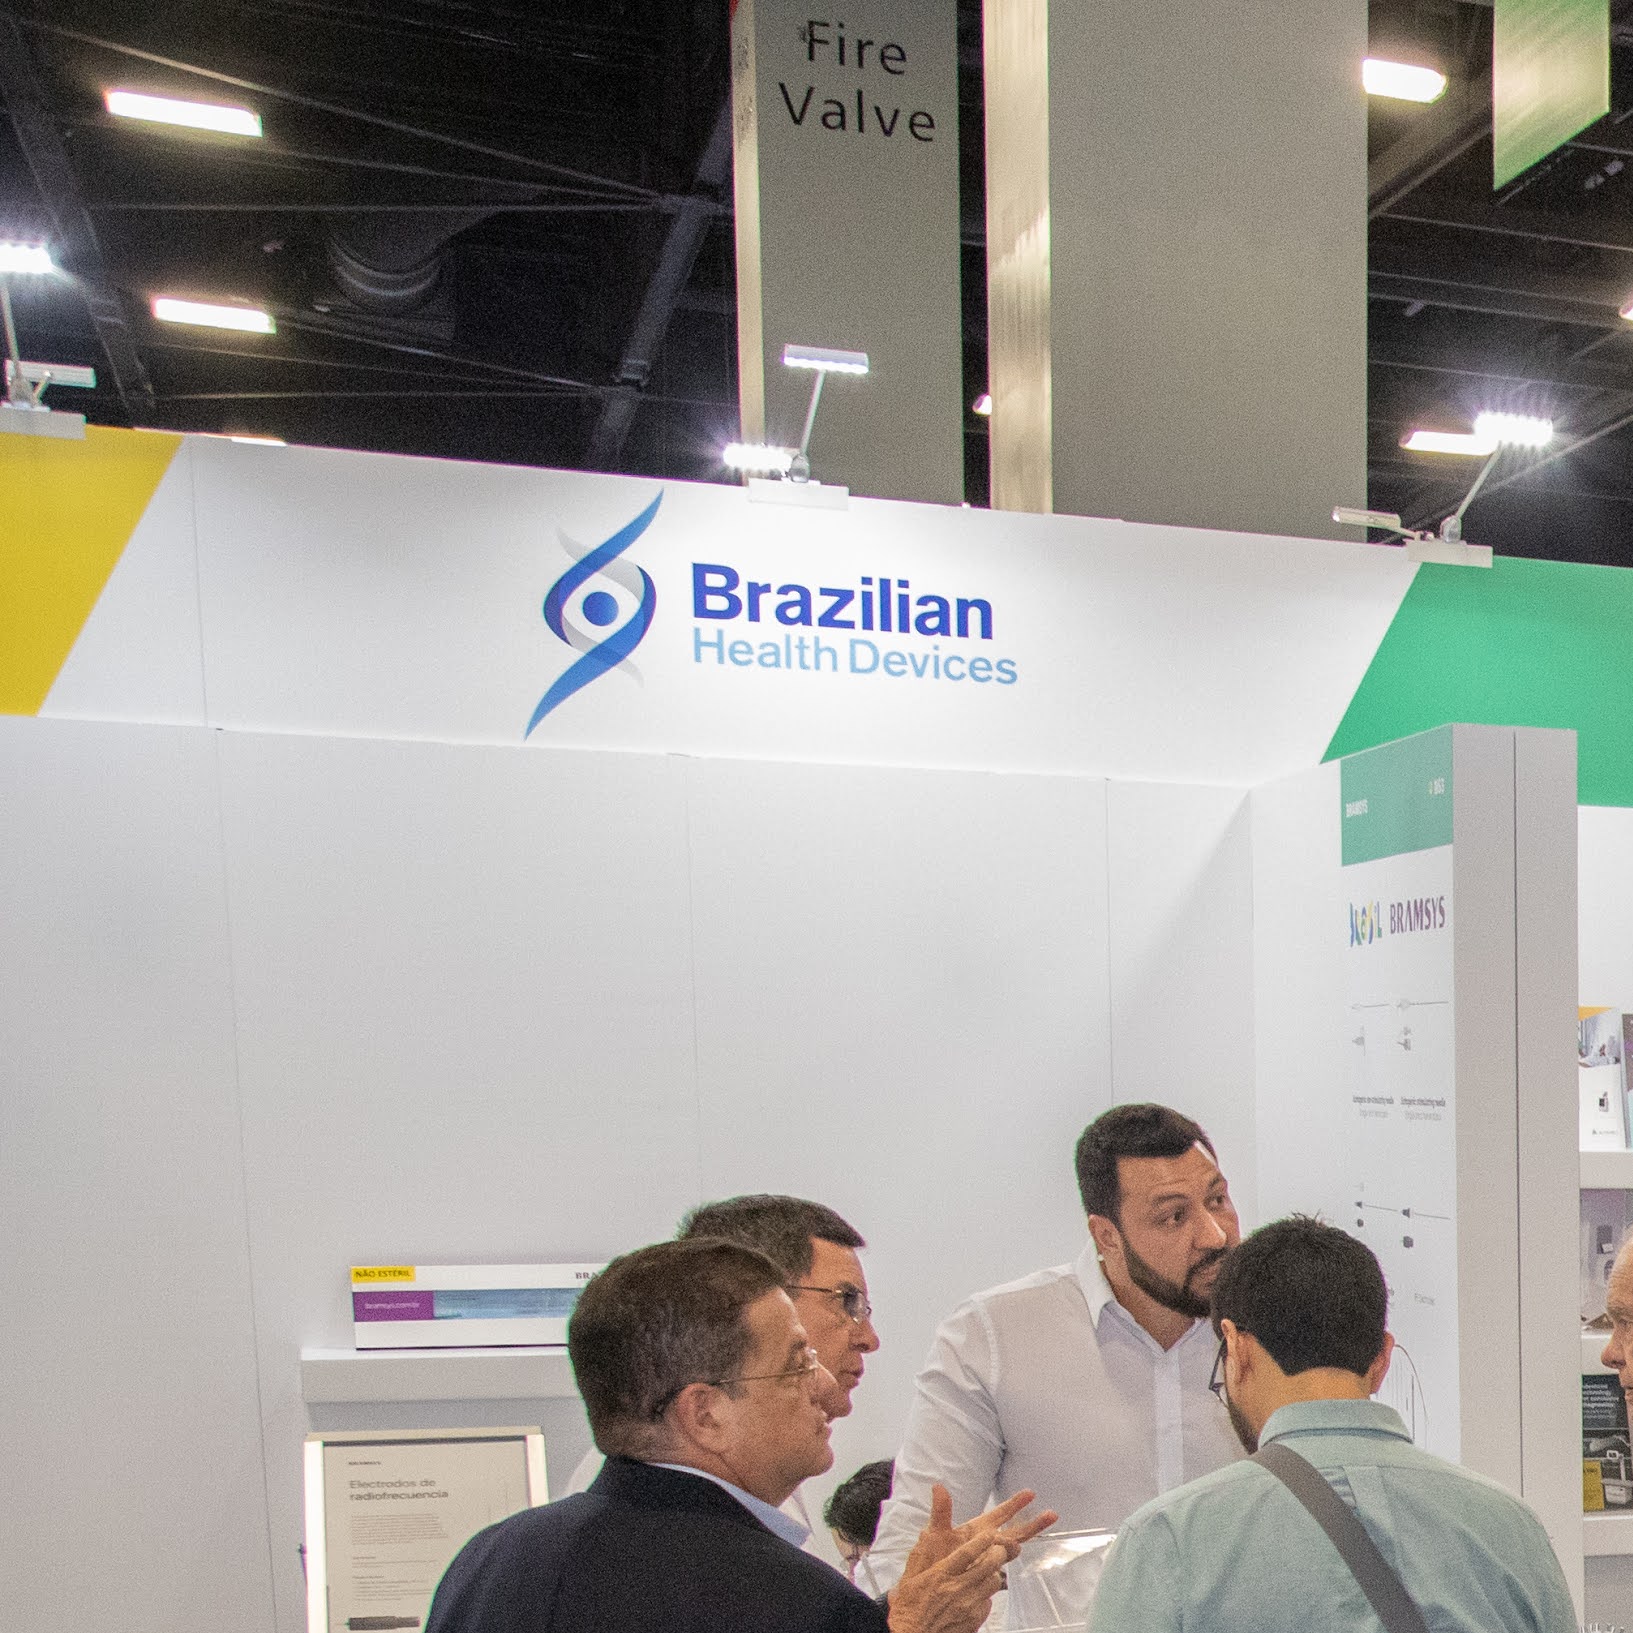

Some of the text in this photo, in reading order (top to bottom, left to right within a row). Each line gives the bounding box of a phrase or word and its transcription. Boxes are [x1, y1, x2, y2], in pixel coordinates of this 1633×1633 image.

[805, 20, 907, 75] Fire
[778, 82, 936, 142] Valve
[692, 562, 993, 640] Brazilian
[693, 626, 1018, 685] Health Devices
[1389, 895, 1446, 935] BRAMSYS
[355, 1267, 376, 1279] NÃO
[349, 1490, 449, 1501] radiofrecuencia
